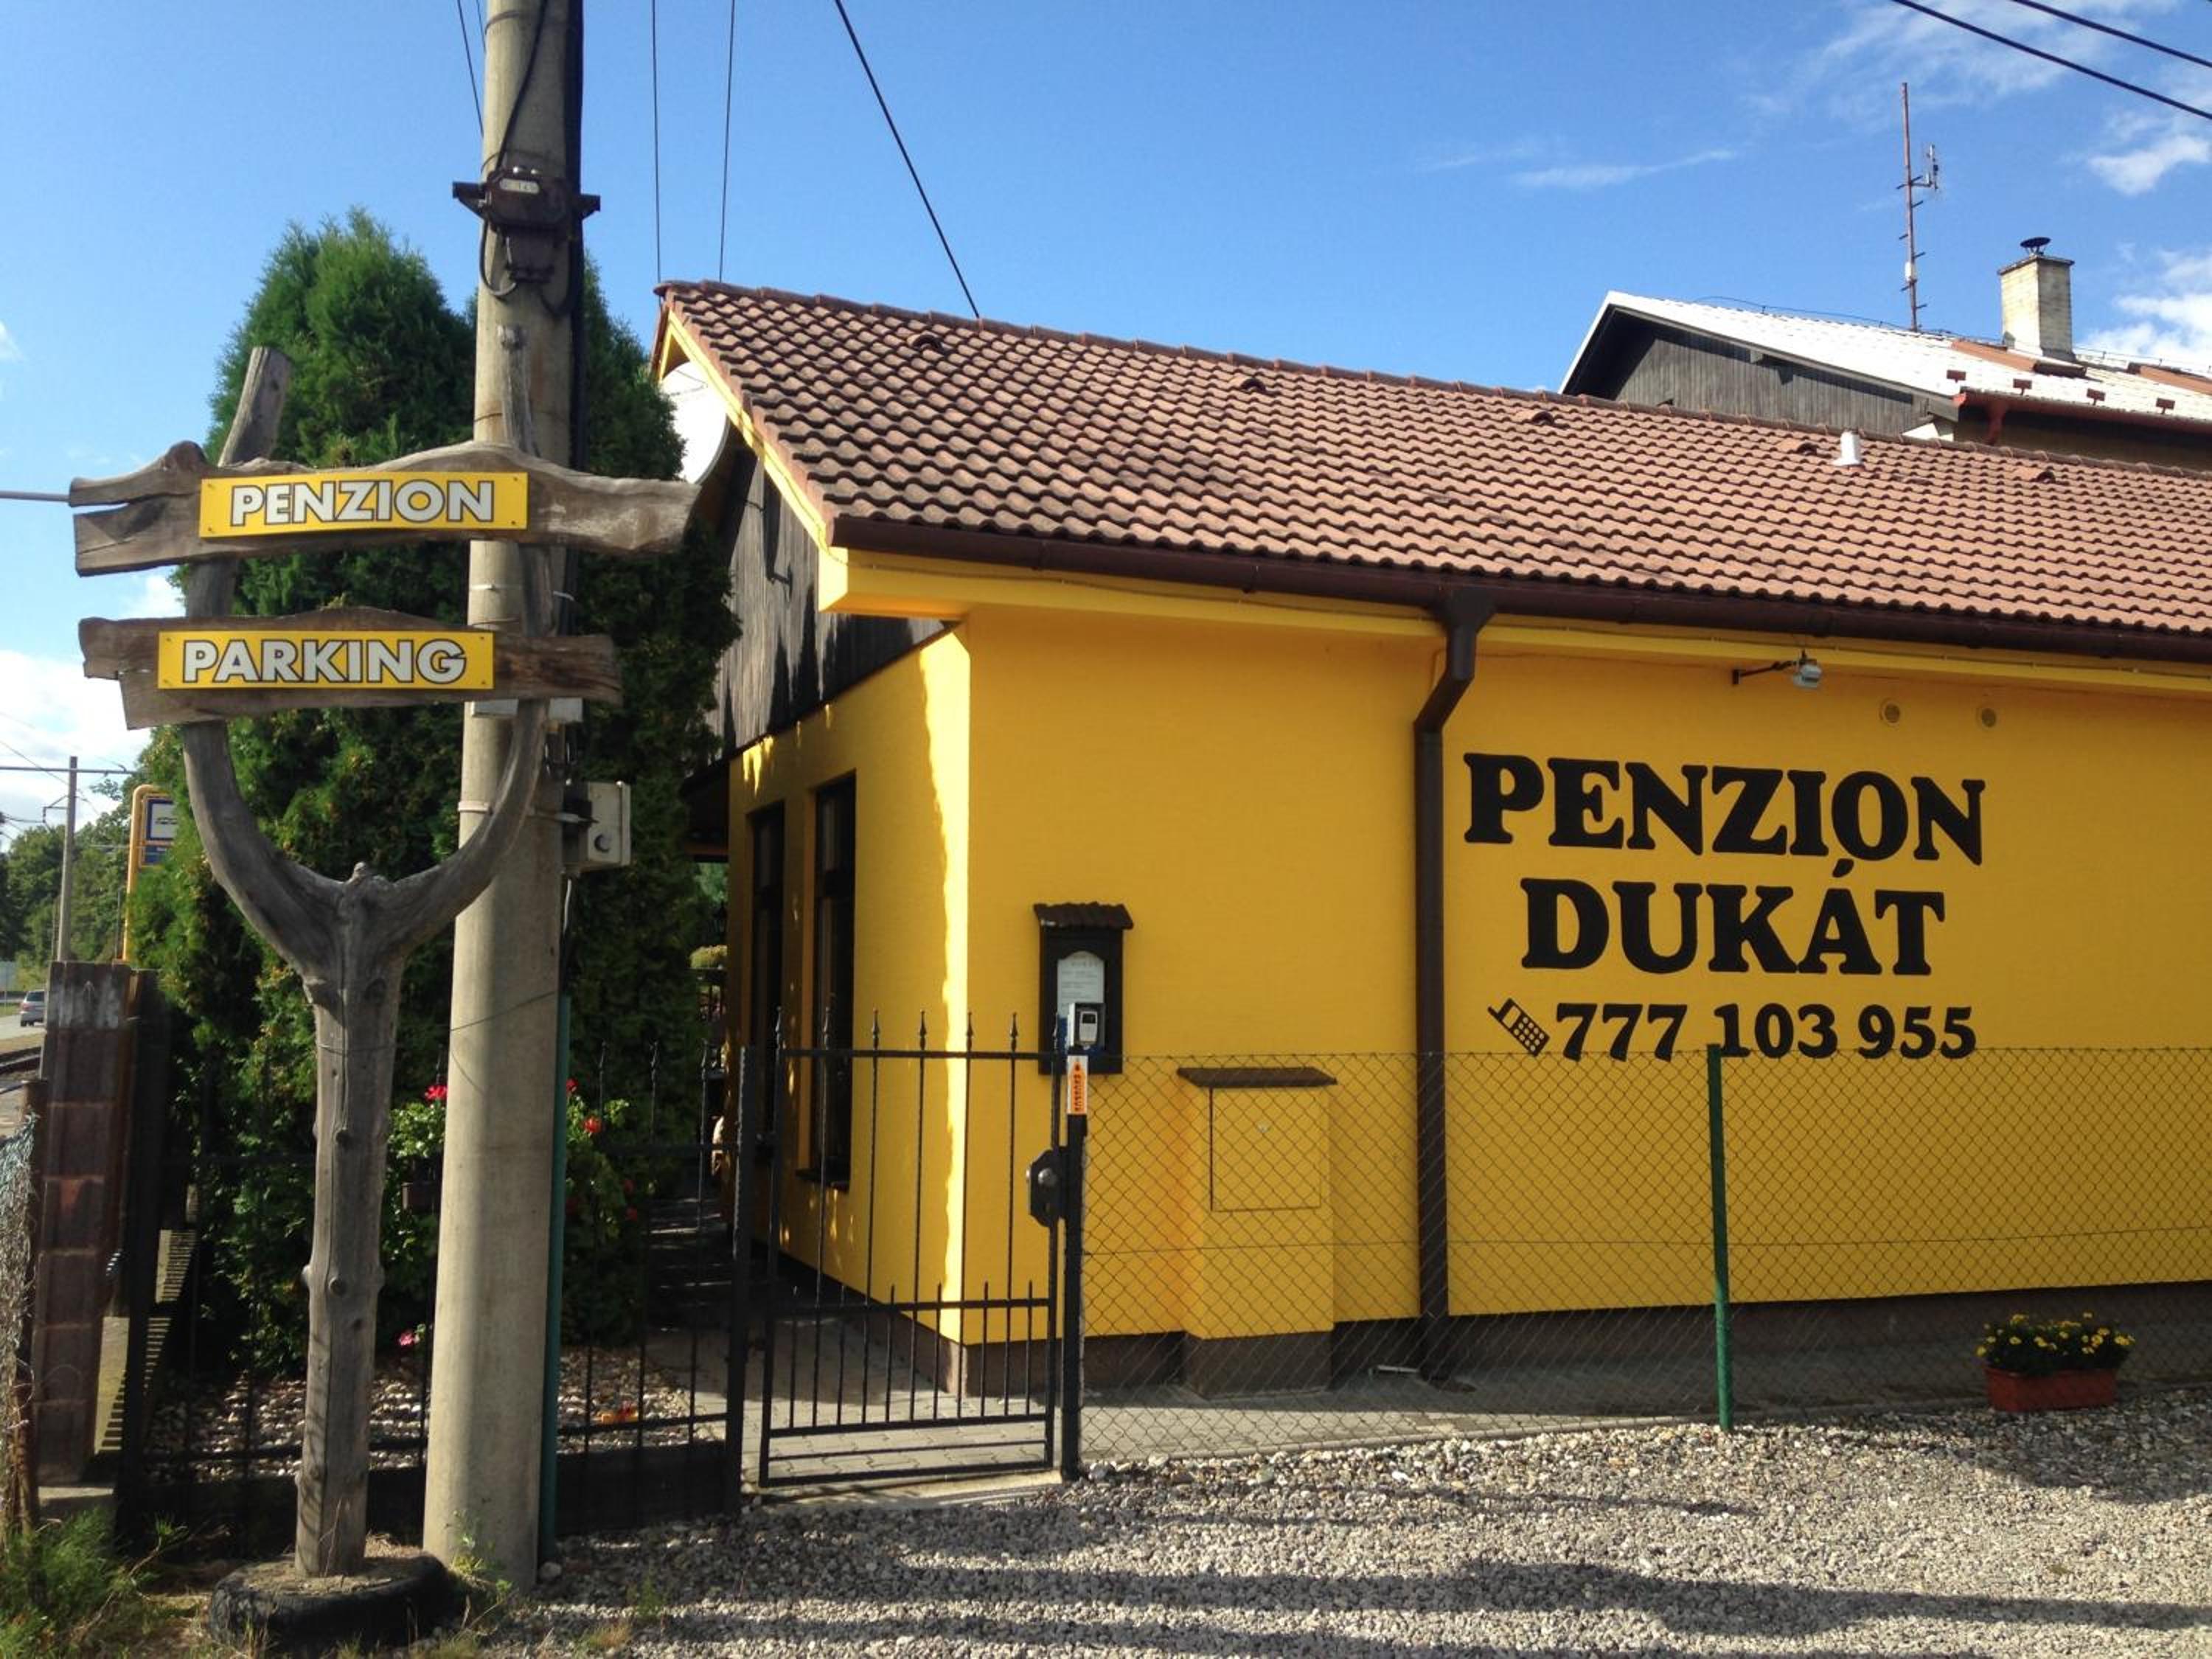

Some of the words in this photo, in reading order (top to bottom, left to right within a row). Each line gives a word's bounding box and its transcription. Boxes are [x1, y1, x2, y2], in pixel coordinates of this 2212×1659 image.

[232, 479, 494, 526] PENZION
[182, 639, 467, 685] PARKING
[1463, 753, 1986, 866] PENZION
[1520, 859, 1945, 975] DUKÁT
[1556, 1003, 1688, 1062] 777
[1714, 1004, 1838, 1060] 103
[1858, 1004, 1976, 1060] 955
